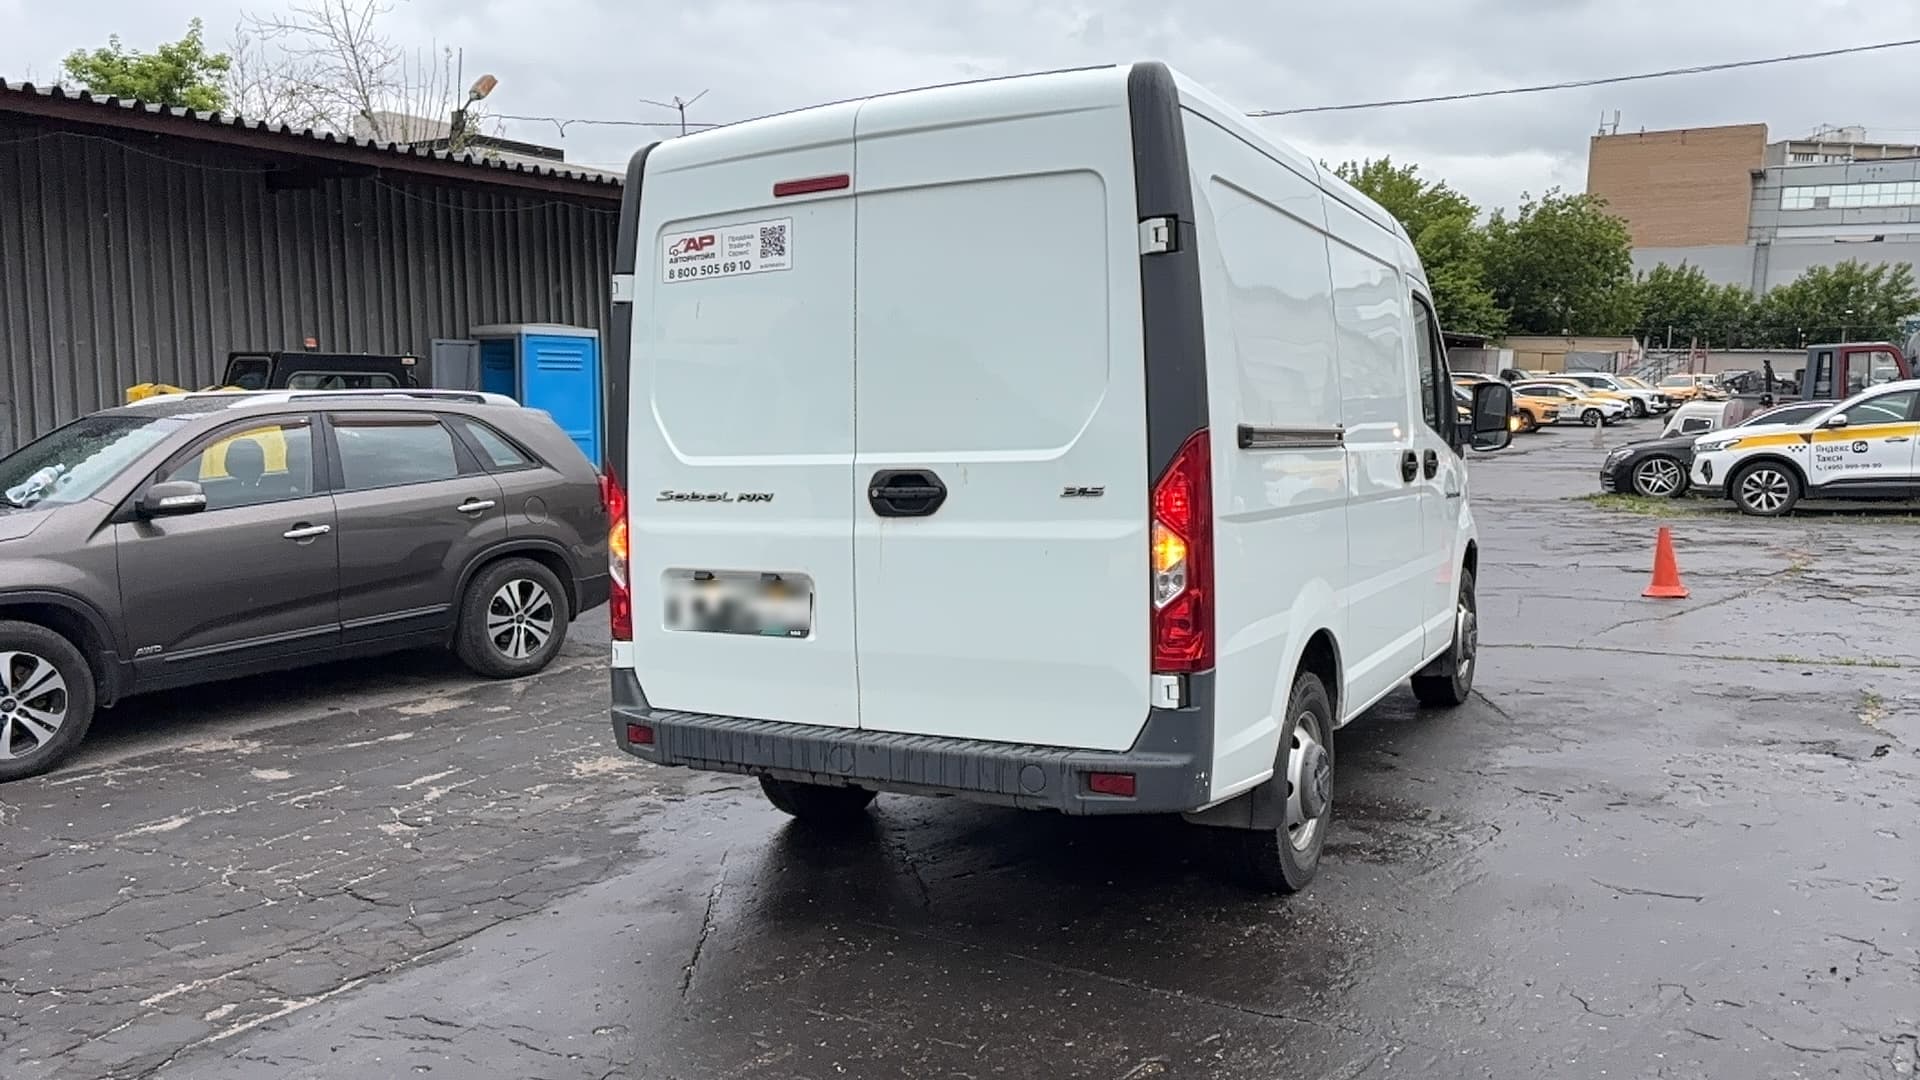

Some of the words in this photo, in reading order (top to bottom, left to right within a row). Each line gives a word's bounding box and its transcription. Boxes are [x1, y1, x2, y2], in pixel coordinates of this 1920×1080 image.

[669, 268, 675, 279] 8
[678, 266, 697, 279] 800
[700, 263, 720, 275] 505
[723, 261, 736, 273] 69
[739, 260, 751, 271] 10
[1853, 441, 1868, 453] Go
[134, 645, 162, 657] AWD
